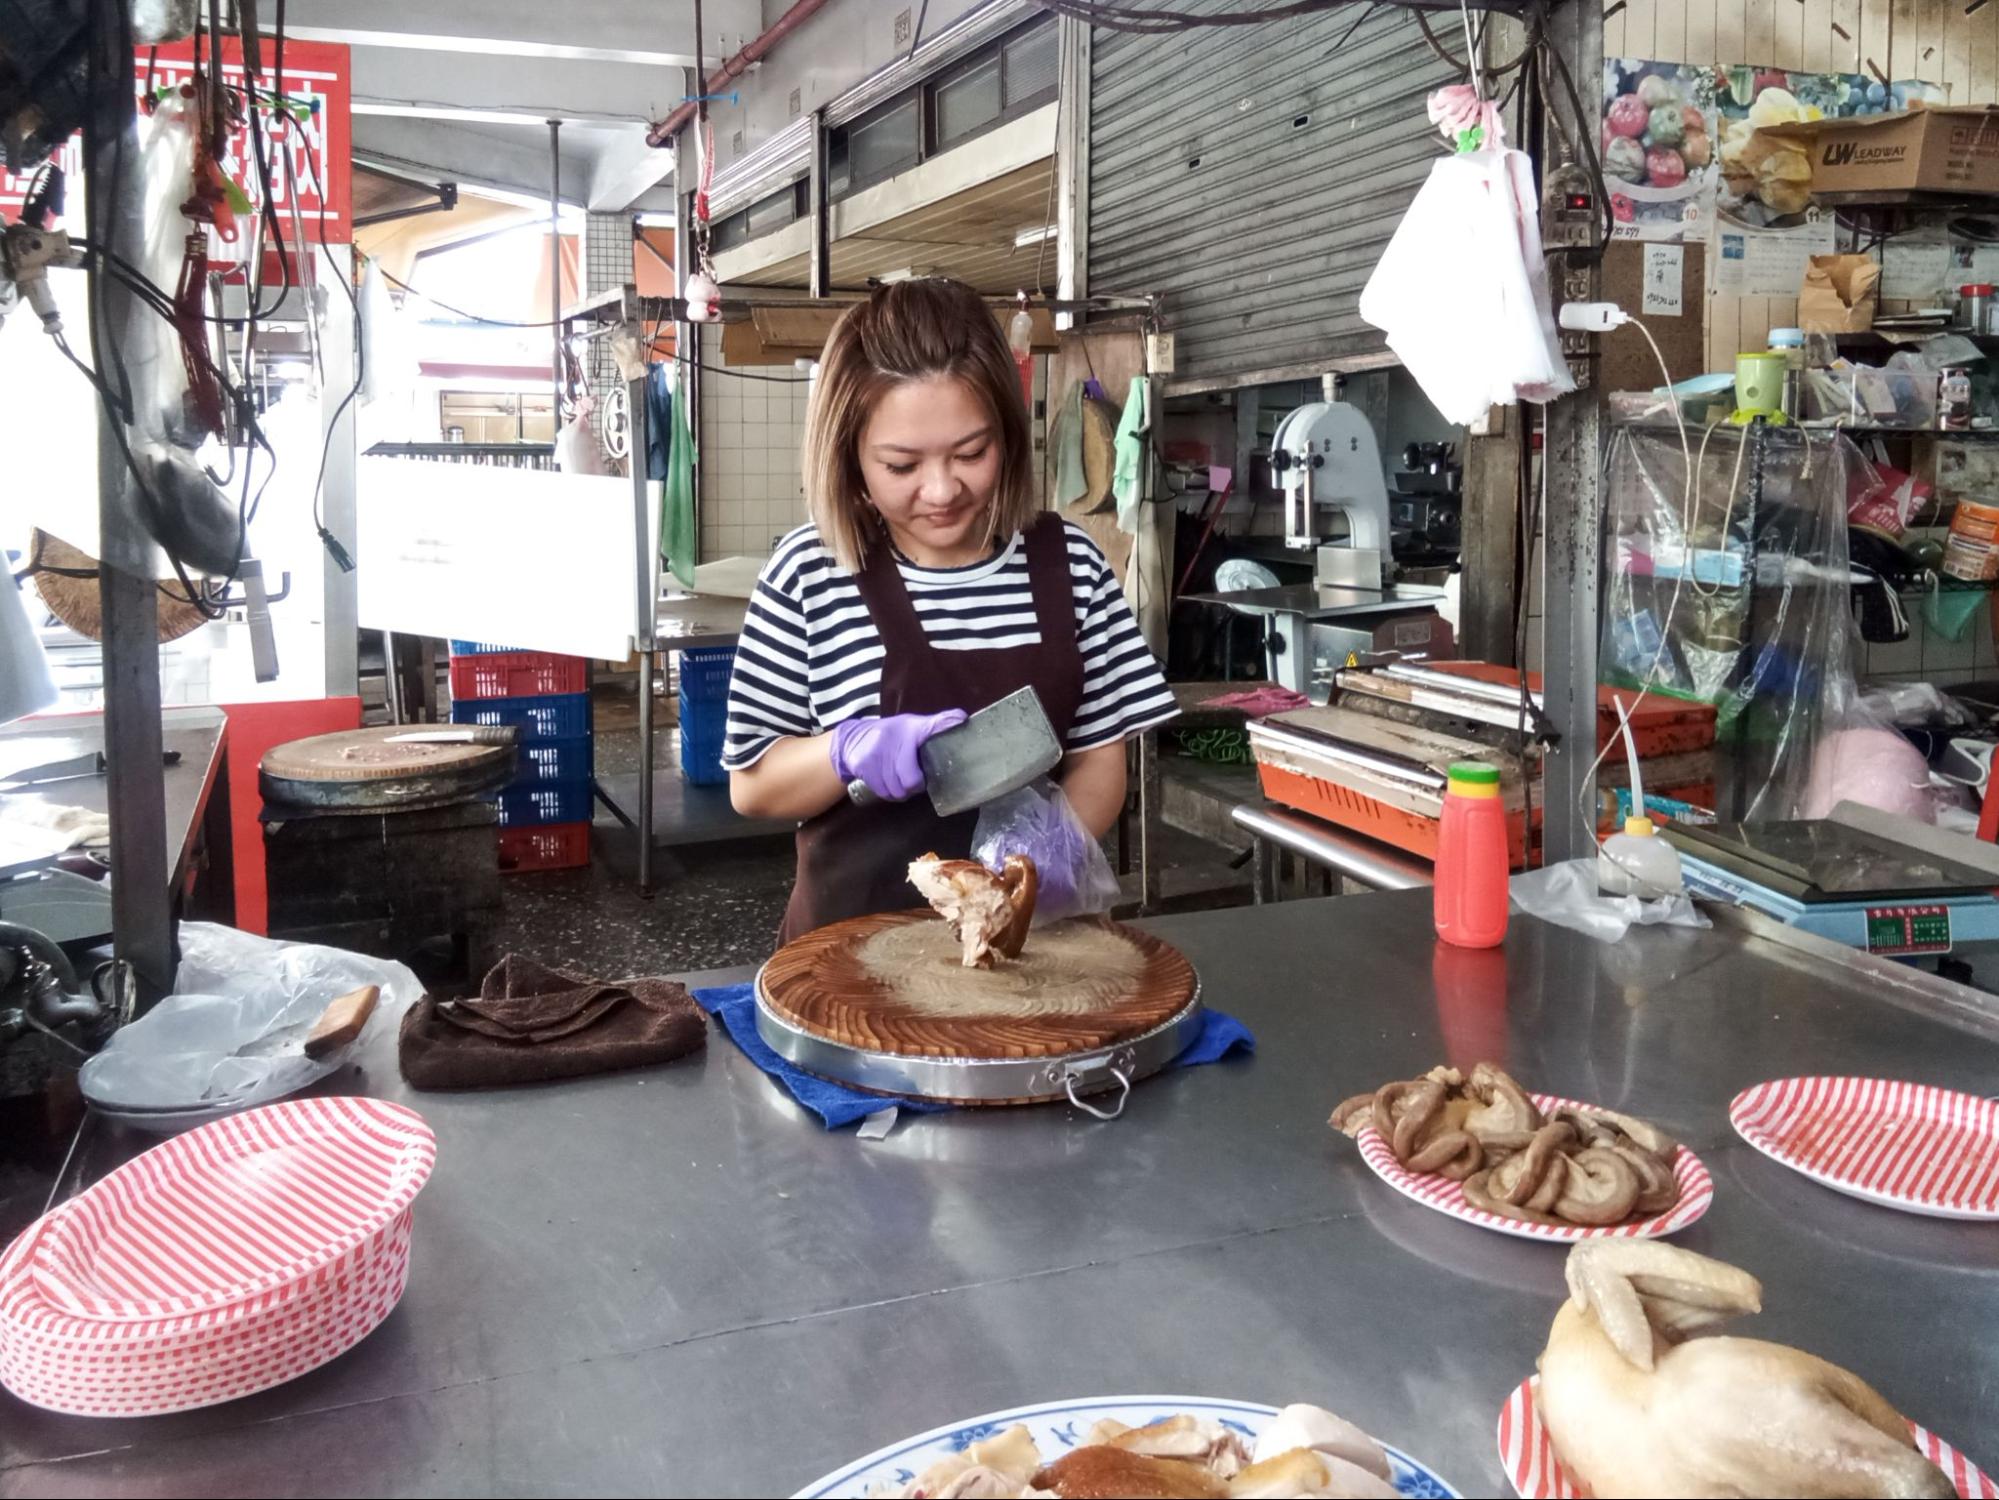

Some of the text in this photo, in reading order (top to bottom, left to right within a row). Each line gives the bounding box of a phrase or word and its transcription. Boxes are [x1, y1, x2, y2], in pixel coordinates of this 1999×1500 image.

[1854, 145, 1907, 159] LEADWAY
[1686, 208, 1698, 221] 10
[1808, 211, 1820, 223] 11
